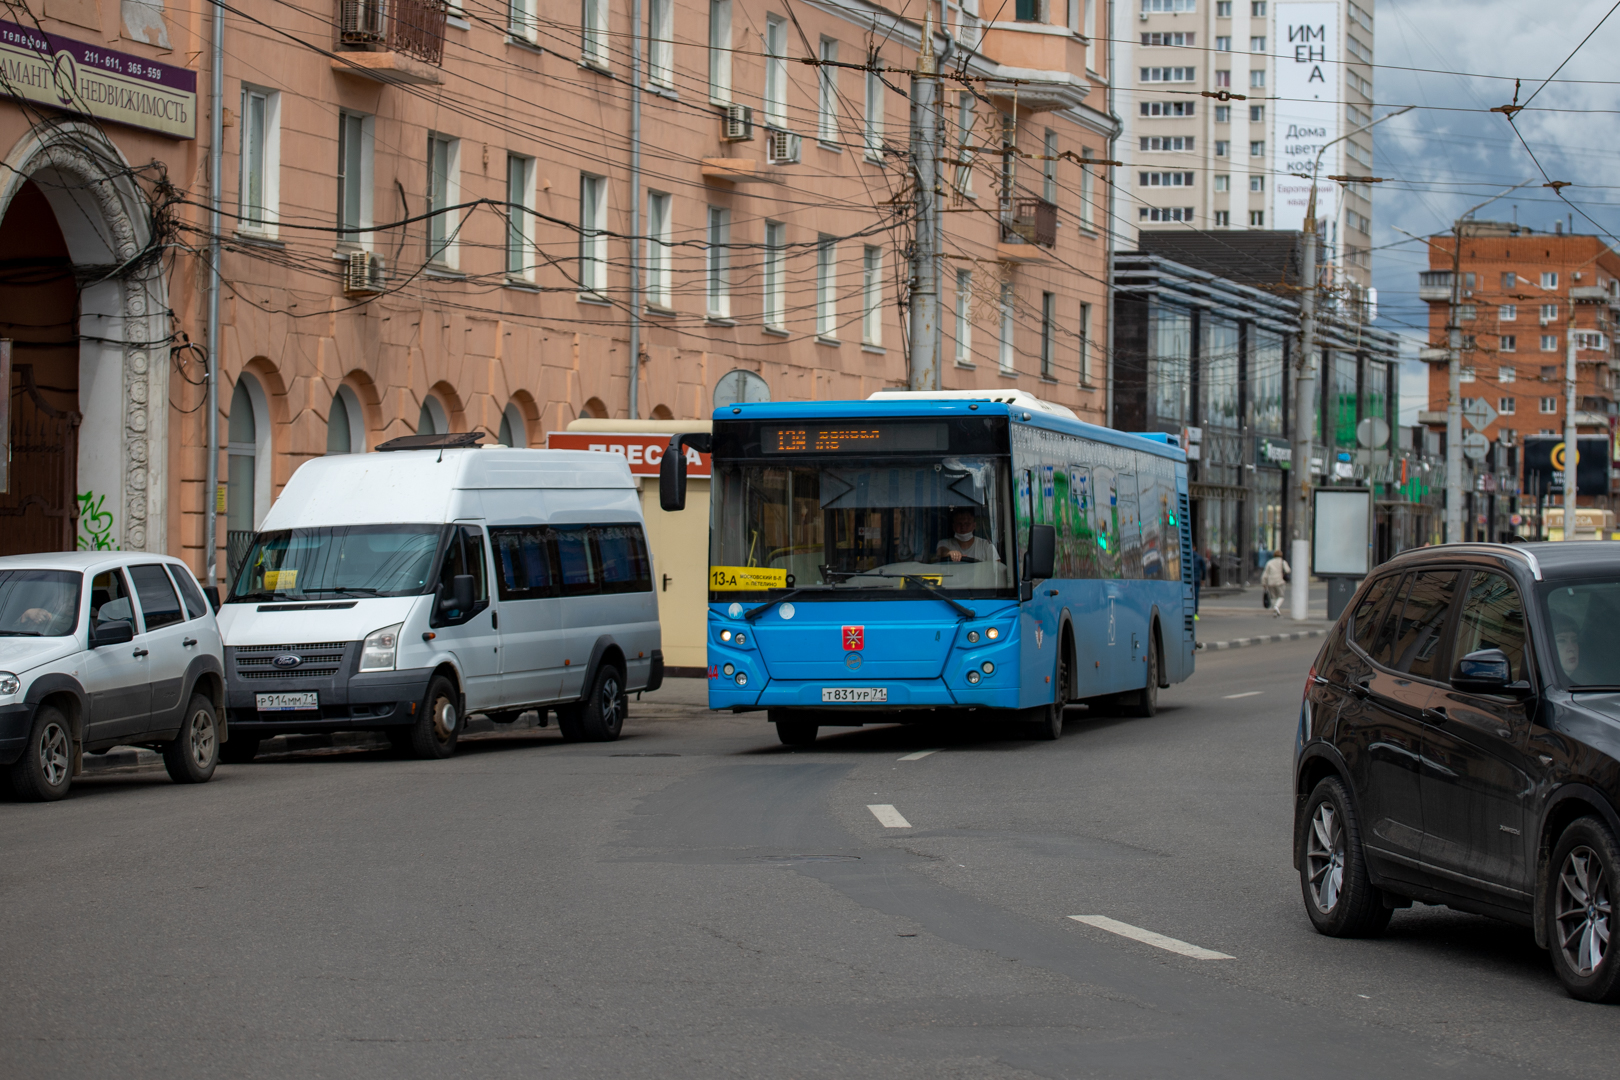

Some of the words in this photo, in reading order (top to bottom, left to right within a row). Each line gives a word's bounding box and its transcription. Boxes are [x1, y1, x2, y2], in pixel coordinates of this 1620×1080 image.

[3, 30, 47, 50] телефон
[127, 61, 162, 80] 365-559
[1285, 124, 1327, 140] Дома
[1286, 159, 1325, 173] кофе
[712, 571, 738, 586] 13-А
[277, 657, 294, 665] Ford
